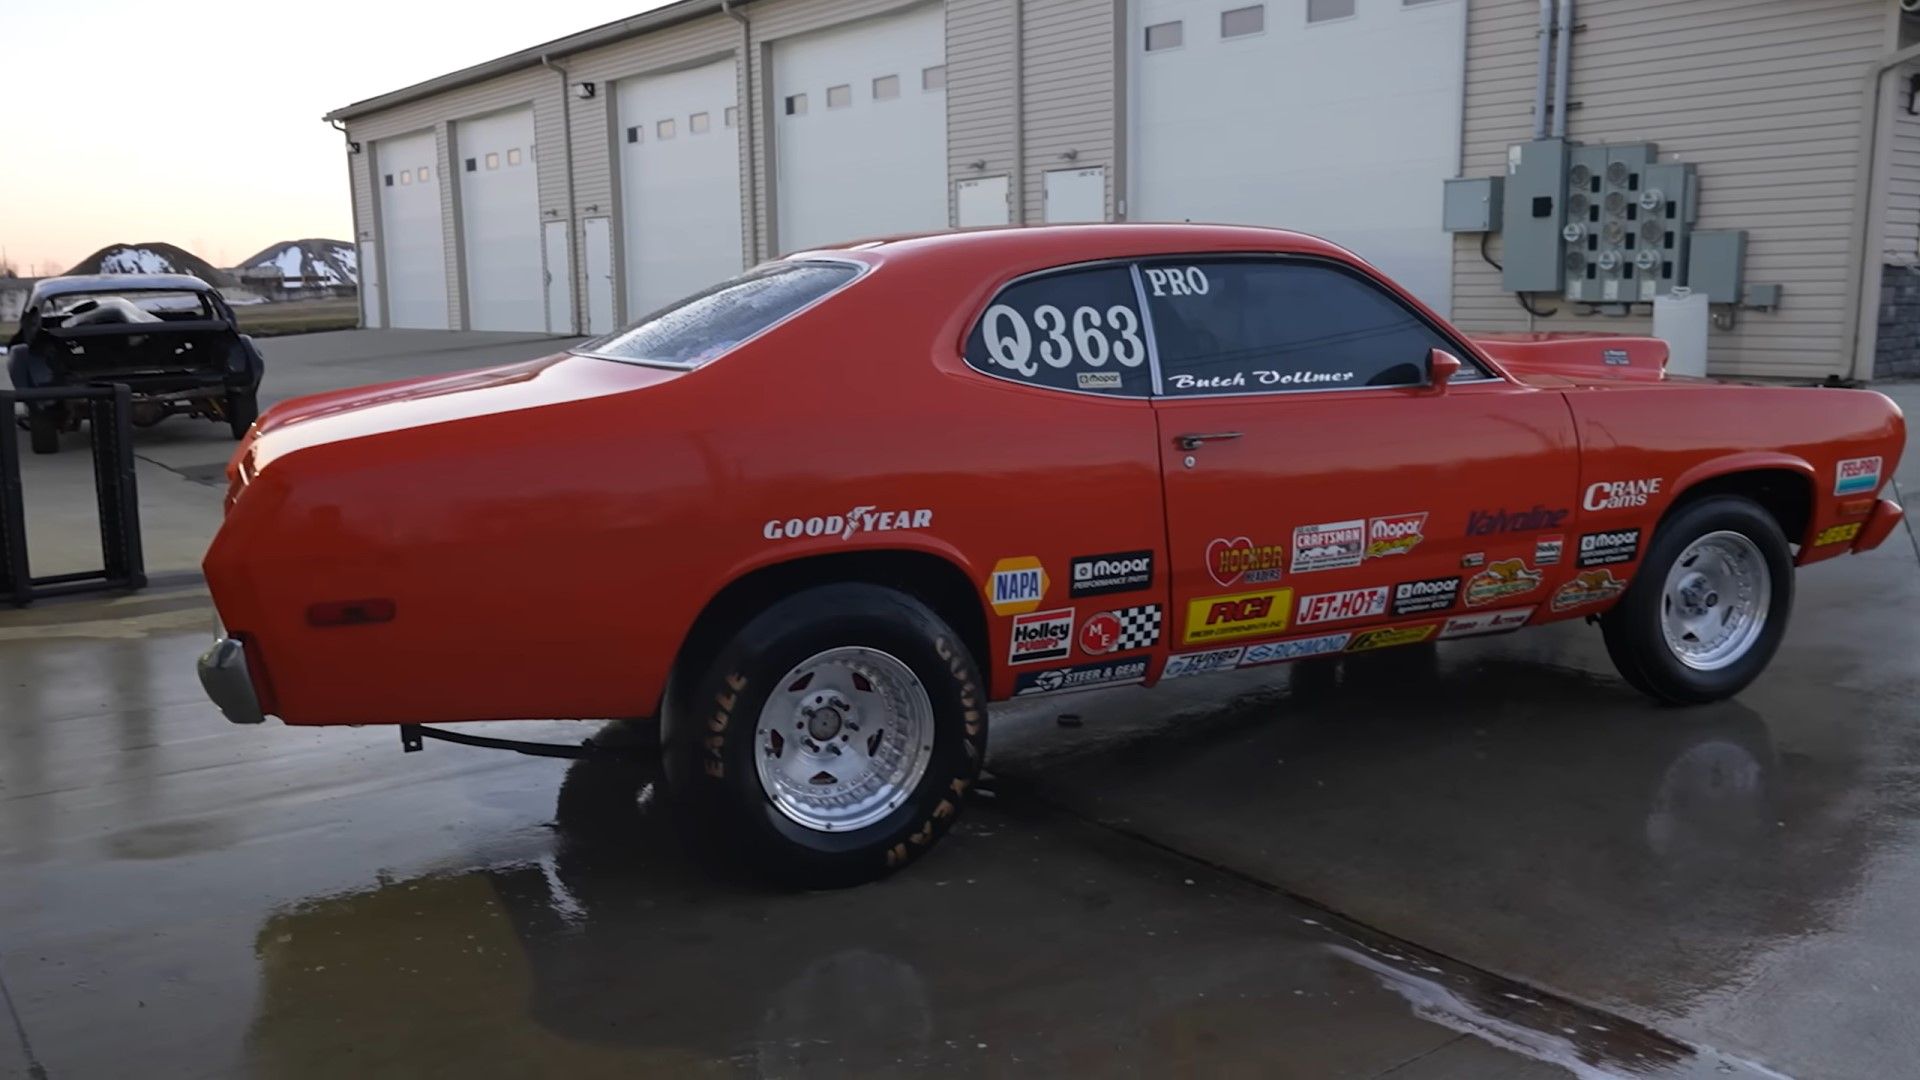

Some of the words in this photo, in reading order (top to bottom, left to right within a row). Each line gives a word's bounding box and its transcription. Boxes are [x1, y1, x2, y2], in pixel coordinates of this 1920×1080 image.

[1145, 266, 1210, 297] PRO
[982, 304, 1145, 378] Q363
[1168, 373, 1246, 389] Butch
[1252, 370, 1354, 386] Vollmer
[1583, 477, 1664, 511] CRANE
[1372, 520, 1420, 539] Mopar
[1466, 506, 1569, 536] Valvoline
[1297, 529, 1361, 549] CRAFTSMAN
[1595, 531, 1639, 547] Mopar
[1093, 558, 1150, 577] Mopar
[1219, 546, 1283, 573] HOOKER
[996, 571, 1040, 601] NAPA
[1412, 578, 1460, 595] Mopar
[1014, 622, 1070, 642] Holley
[1179, 649, 1240, 663] TURBO
[1063, 669, 1103, 685] STEER
[1102, 667, 1113, 681] &
[1114, 662, 1146, 677] GEAR
[704, 671, 749, 780] EAGLE
